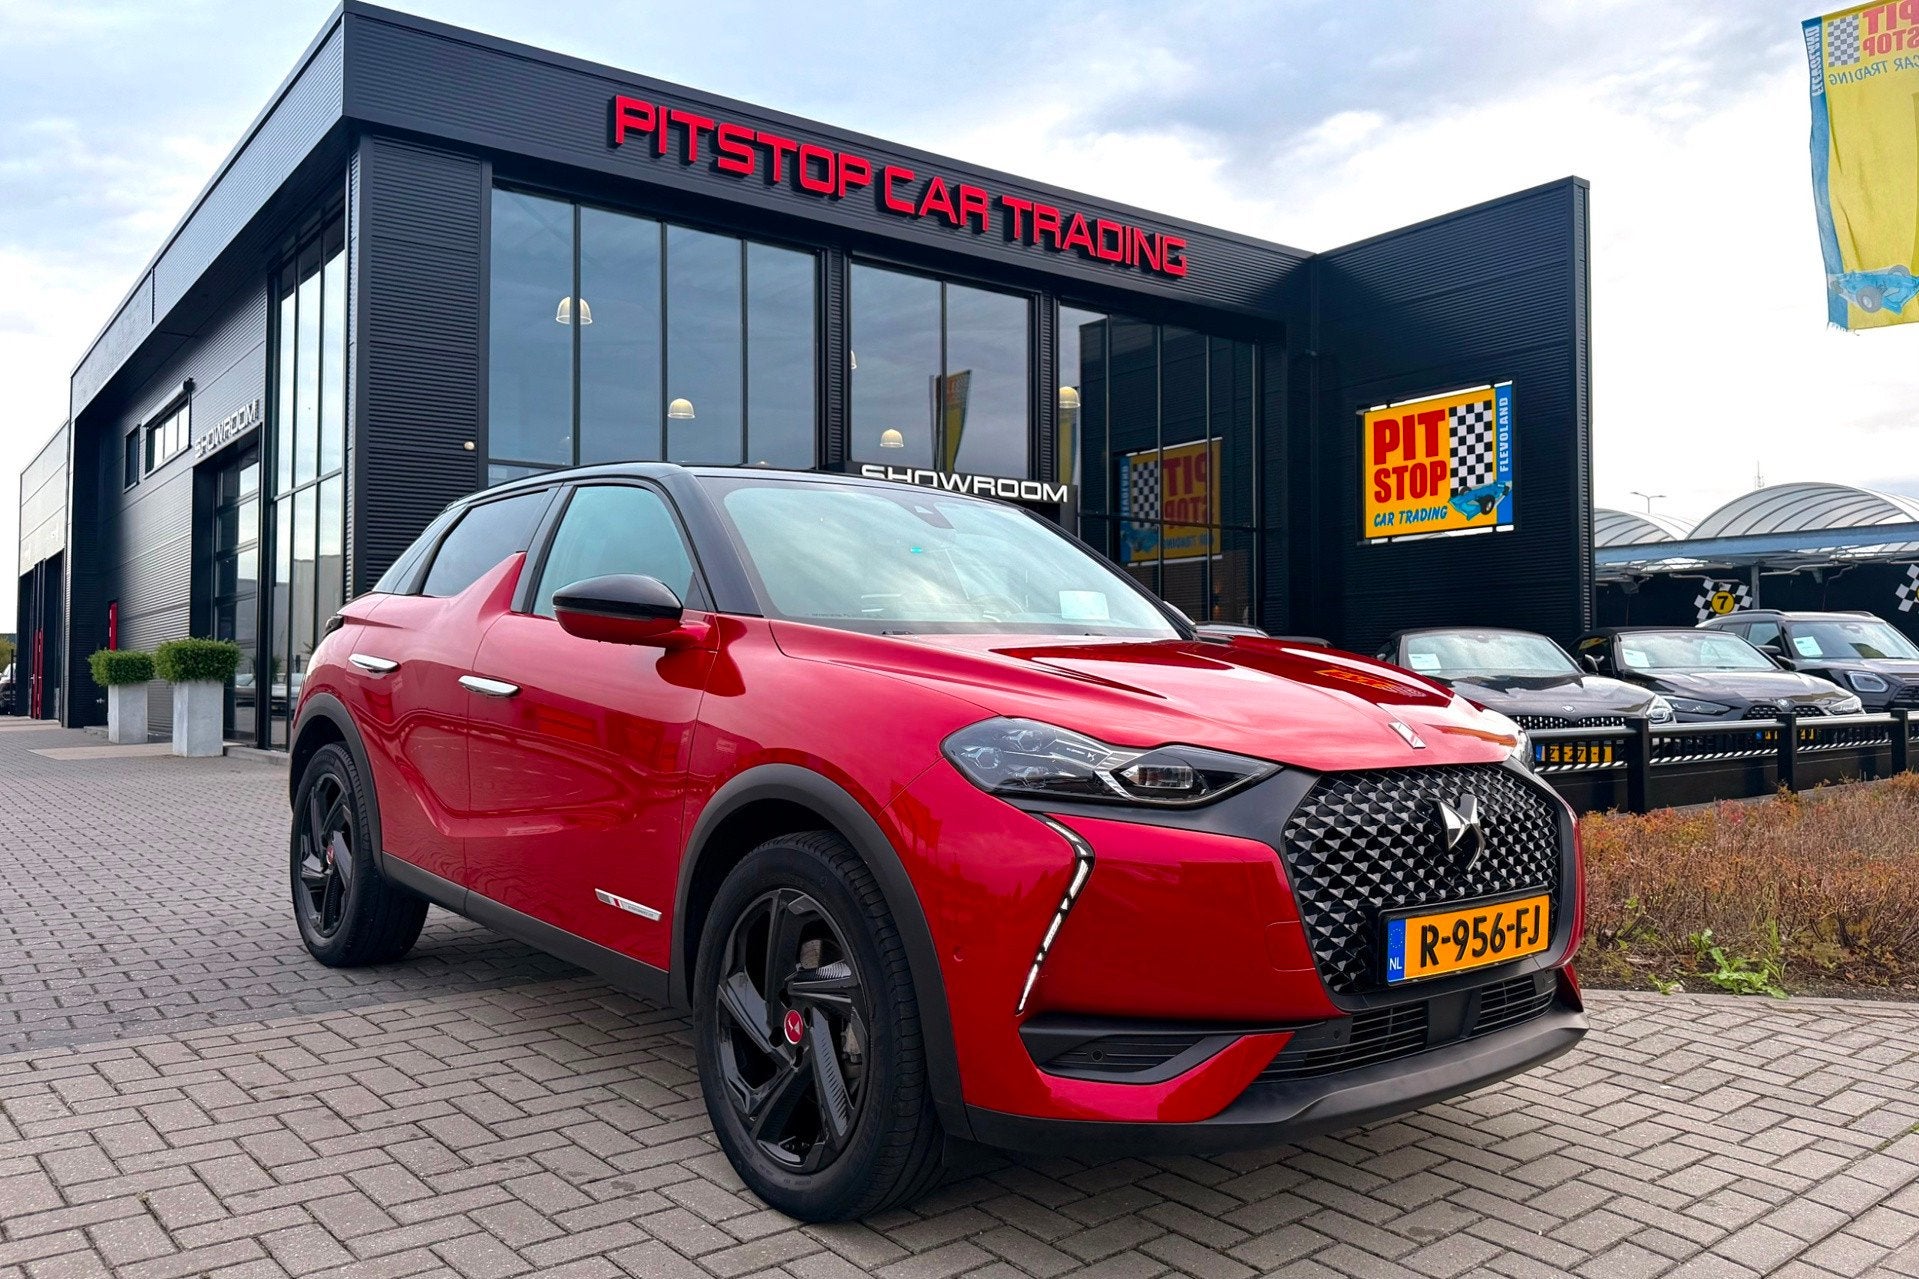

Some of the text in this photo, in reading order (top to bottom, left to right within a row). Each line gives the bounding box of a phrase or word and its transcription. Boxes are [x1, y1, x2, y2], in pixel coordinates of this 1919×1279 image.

[614, 94, 1188, 278] PITSTOP CAR TRADING
[194, 398, 259, 459] SHOWROOM
[1373, 408, 1446, 466] PIT
[1499, 396, 1509, 473] FLEVOLAND
[861, 464, 1068, 503] SHOWROOM
[1373, 460, 1447, 504] STOP
[1373, 505, 1449, 528] CAR TRADING
[1716, 595, 1729, 610] 7
[1420, 904, 1541, 969] R-956-FJ
[1389, 956, 1403, 971] NL
